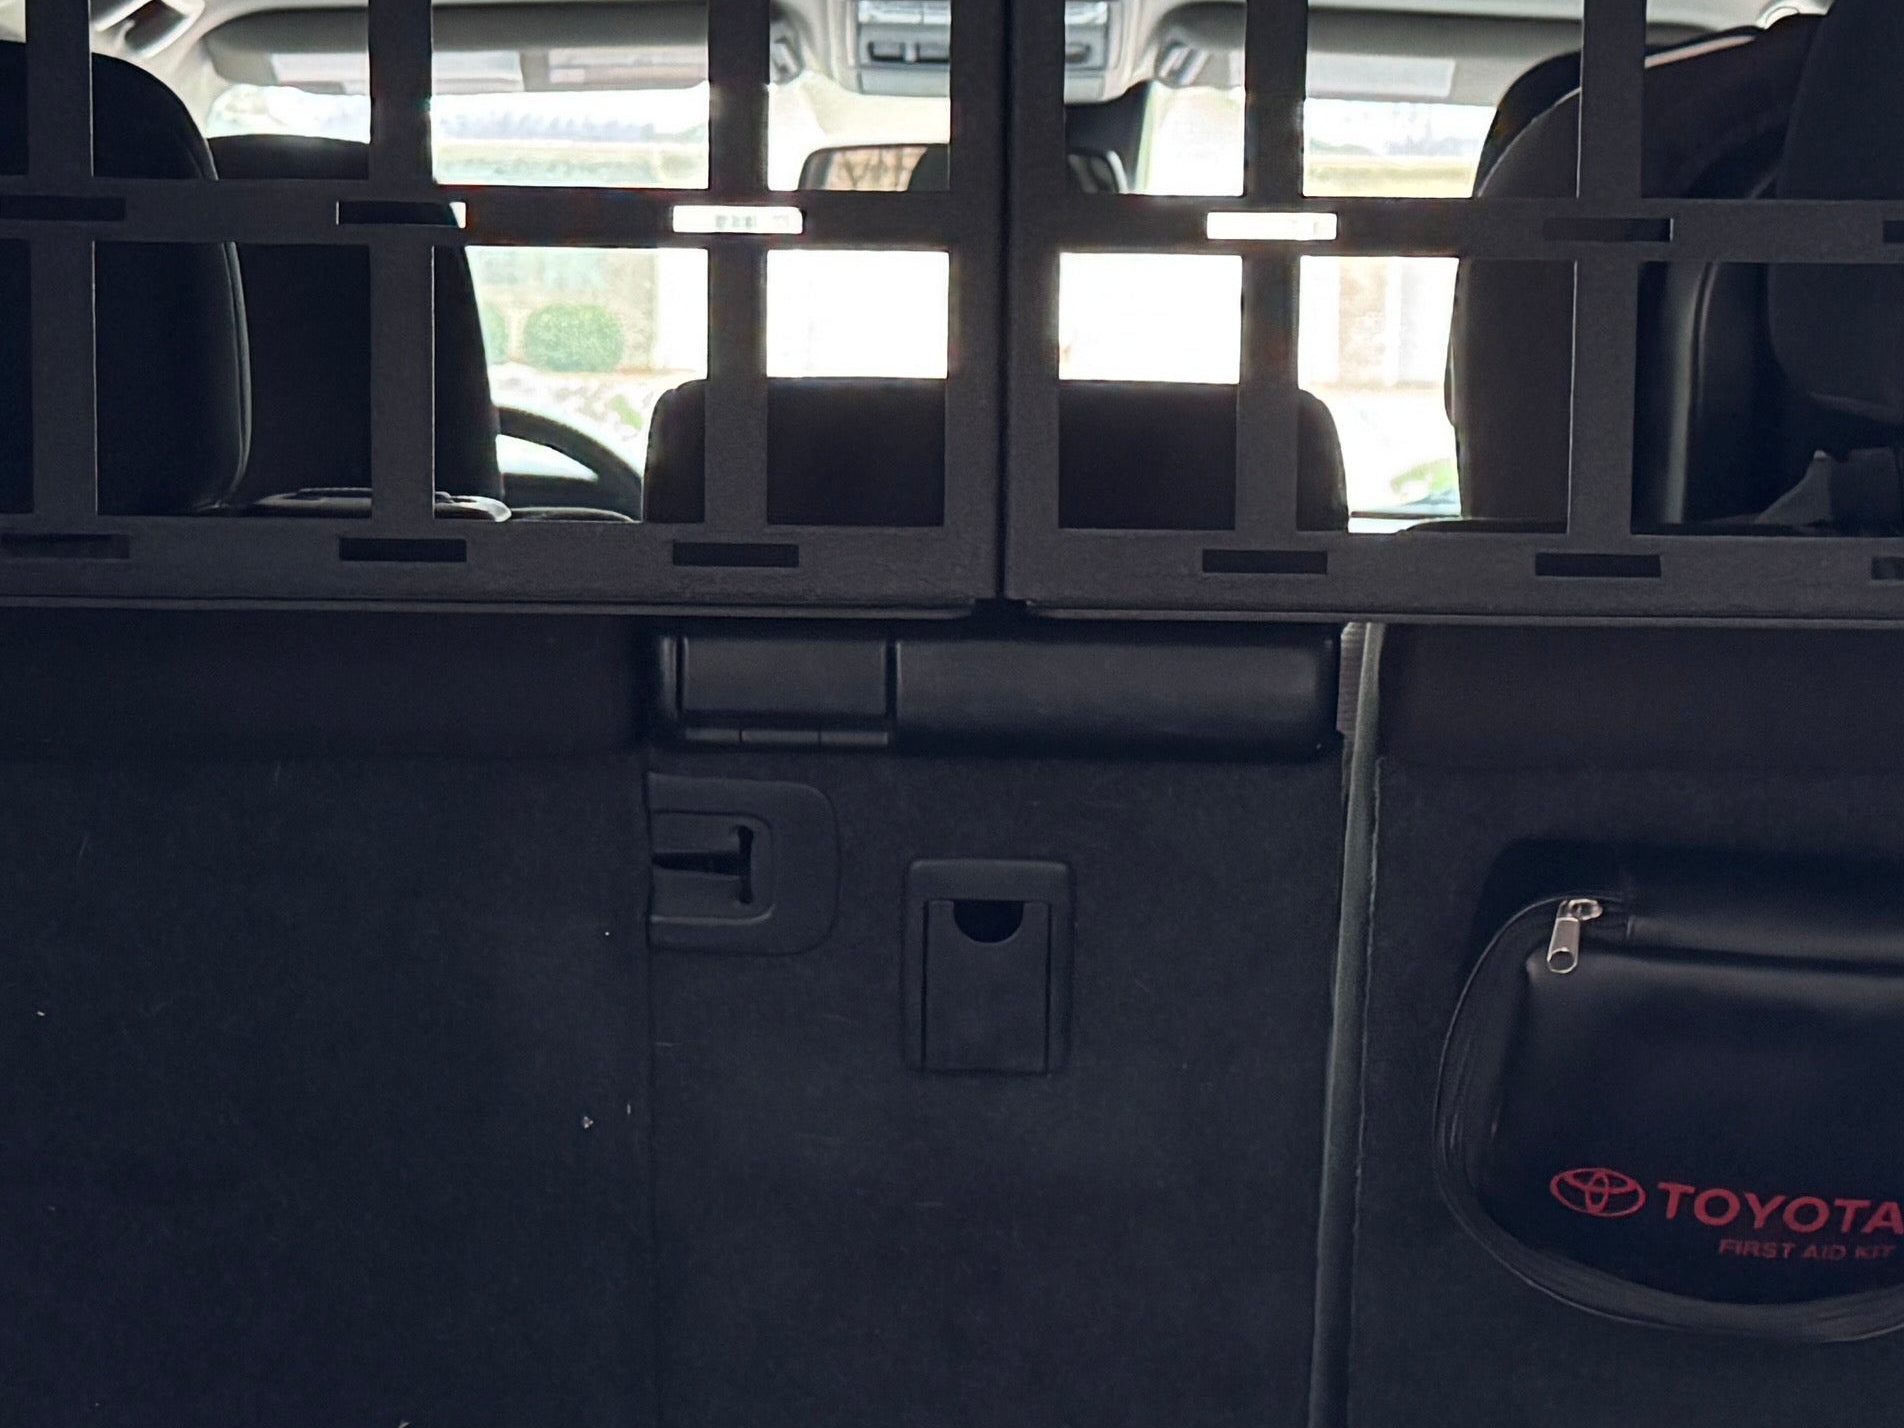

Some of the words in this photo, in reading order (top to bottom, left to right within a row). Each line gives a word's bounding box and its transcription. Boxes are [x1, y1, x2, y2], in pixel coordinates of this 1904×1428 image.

[1657, 1182, 1904, 1235] TOYOTA
[1719, 1238, 1795, 1259] FIRST
[1801, 1243, 1846, 1261] AID
[1854, 1245, 1895, 1260] KIT
